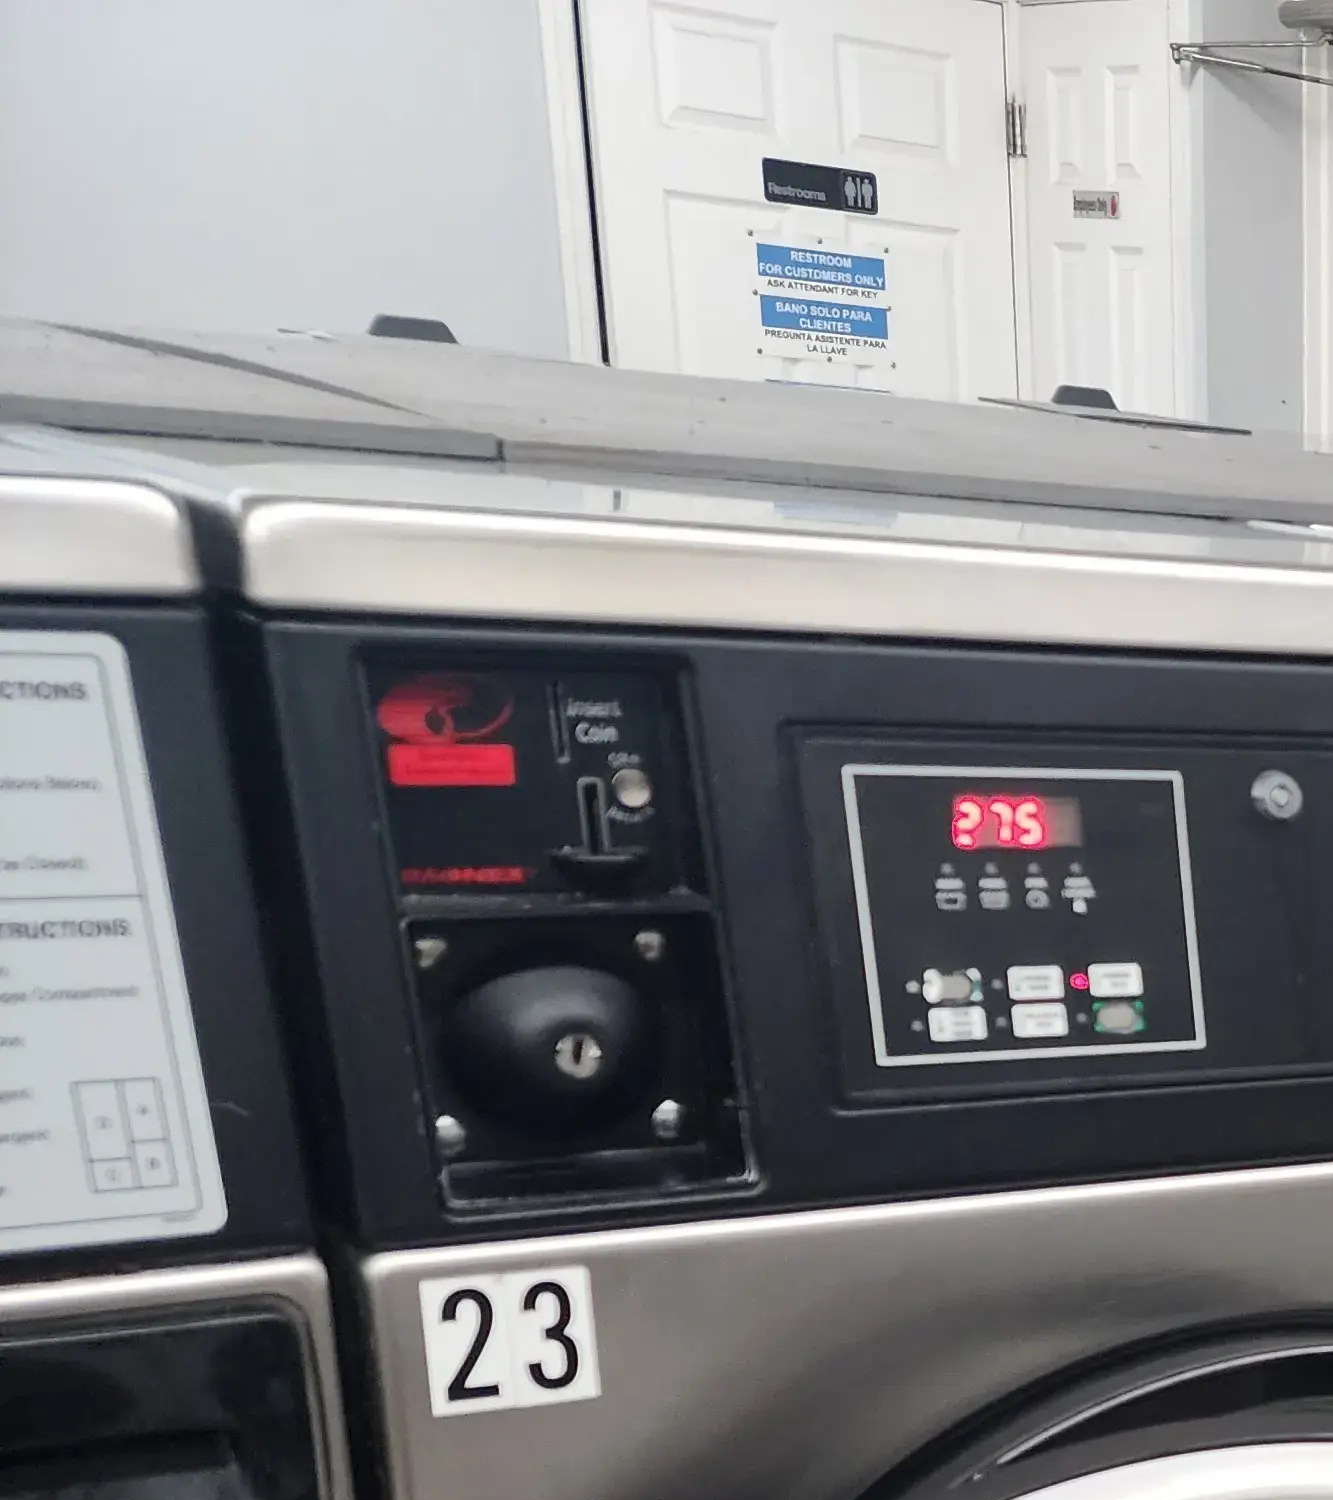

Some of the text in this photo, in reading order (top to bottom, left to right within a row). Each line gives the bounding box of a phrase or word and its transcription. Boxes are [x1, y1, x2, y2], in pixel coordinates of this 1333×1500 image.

[767, 181, 827, 202] Restrooms
[790, 250, 852, 269] RESTROOM
[759, 262, 884, 288] FOR CUSTOMERS ONLY
[767, 279, 878, 299] ASK ATTENDANT FOR KEY
[810, 305, 840, 319] SOLO
[842, 308, 873, 322] PARA
[799, 317, 852, 333] CLIENTES
[765, 329, 887, 350] PREGUNTA ASISTENTE PARA
[807, 344, 848, 356] LA LLAVE
[441, 1281, 578, 1401] 23
